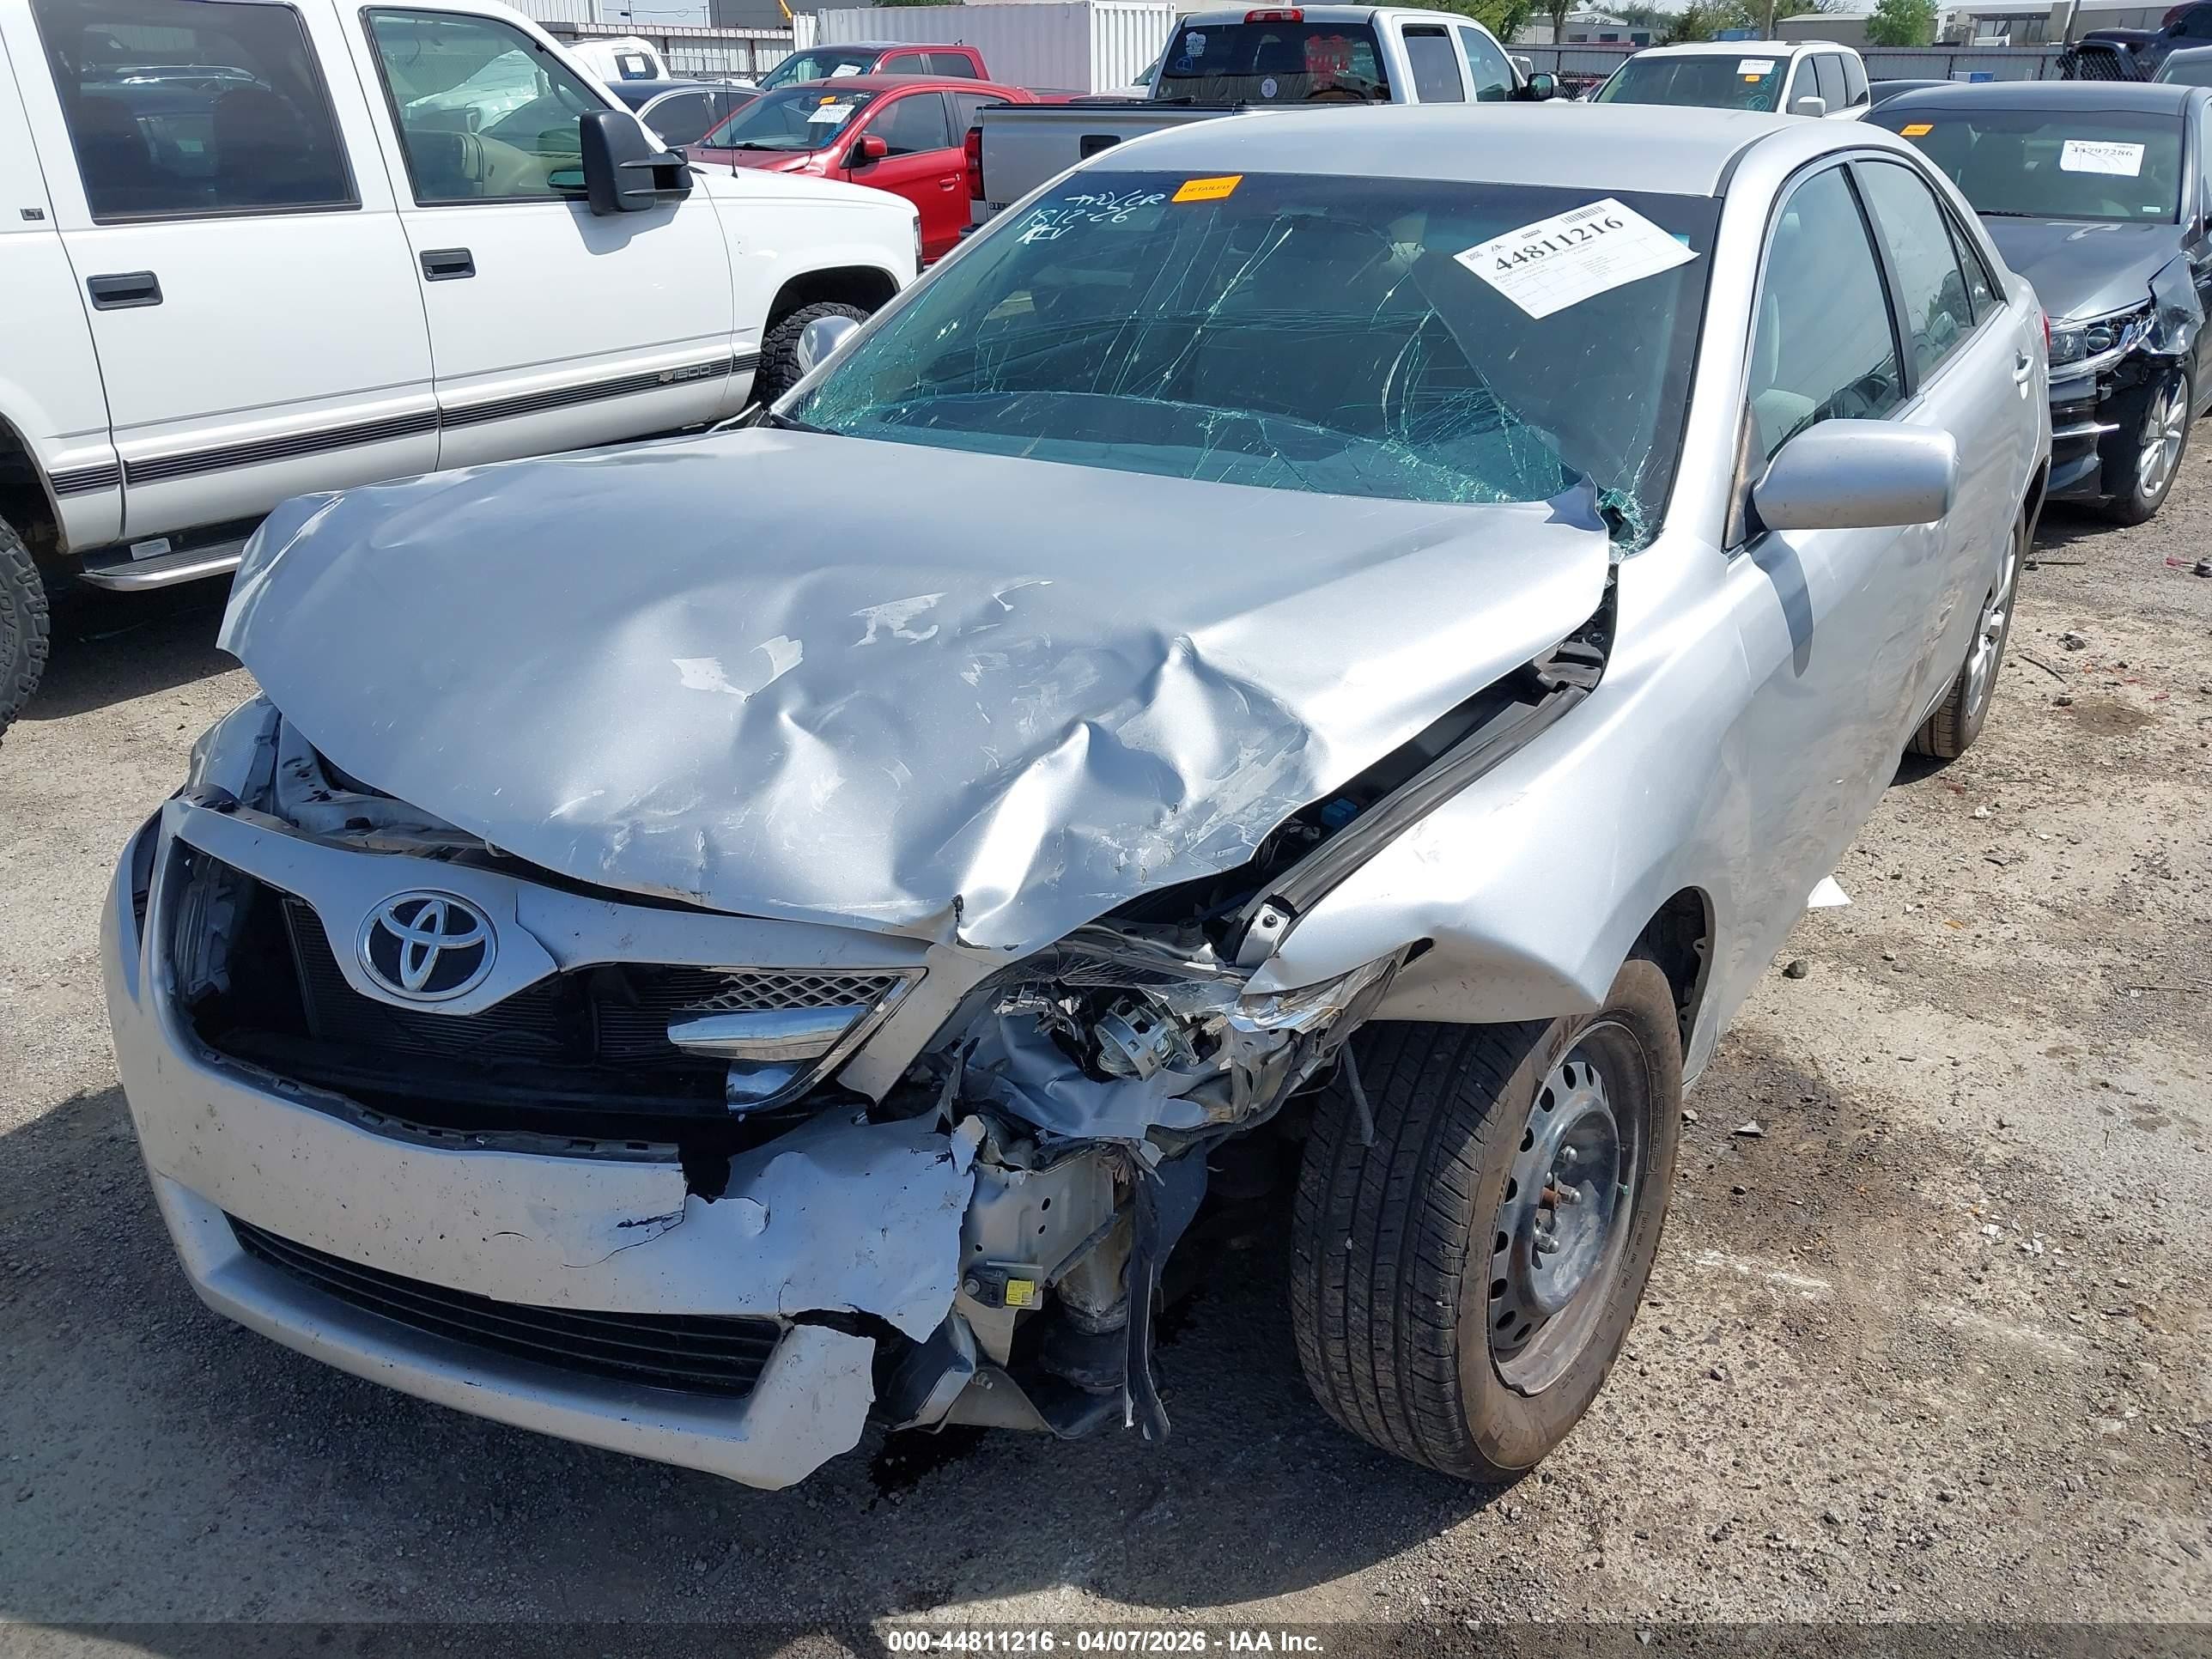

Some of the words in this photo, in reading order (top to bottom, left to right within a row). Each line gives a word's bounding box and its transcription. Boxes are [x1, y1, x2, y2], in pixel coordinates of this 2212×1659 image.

[1183, 184, 1231, 193] DETAILED
[21, 209, 42, 220] LT
[1495, 216, 1624, 271] 44811216
[674, 365, 710, 380] 1500
